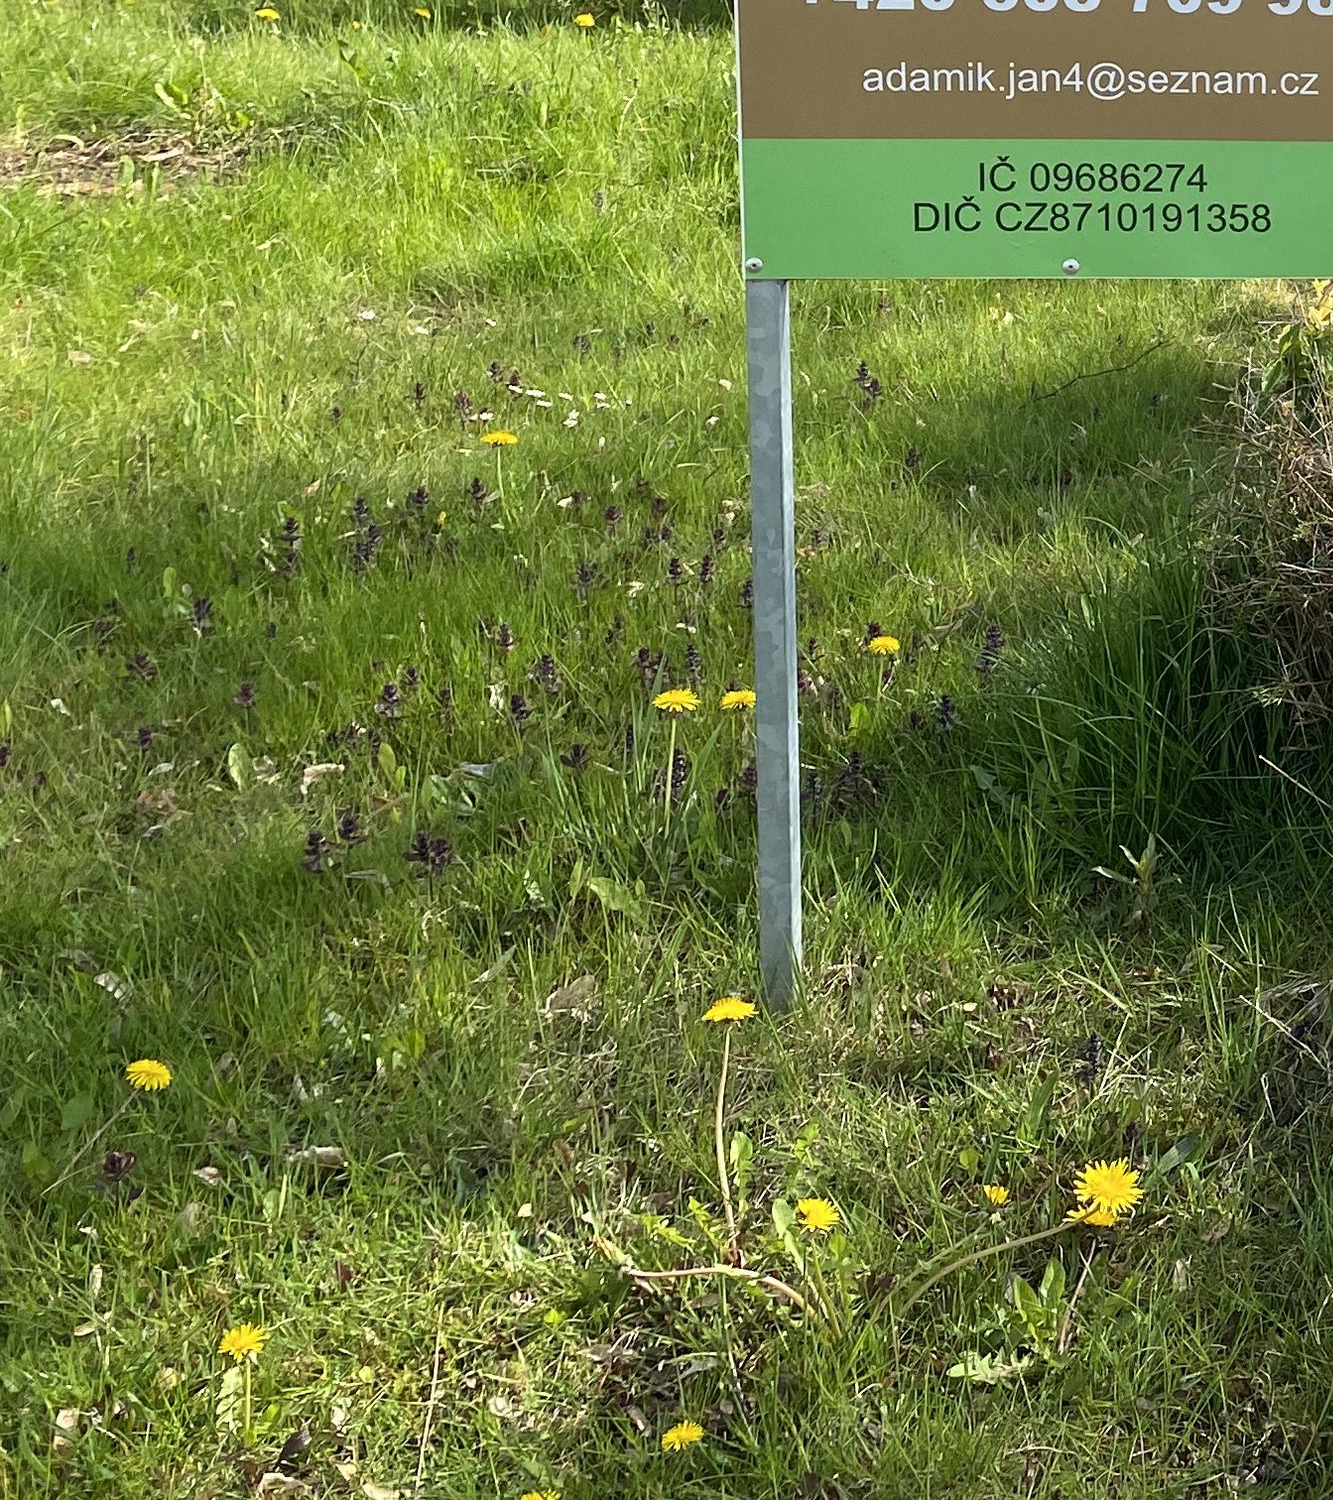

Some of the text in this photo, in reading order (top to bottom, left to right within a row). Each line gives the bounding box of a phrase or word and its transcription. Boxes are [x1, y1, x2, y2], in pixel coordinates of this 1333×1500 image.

[862, 61, 1320, 101] adamik.jan4@seznam.cz
[978, 155, 1208, 193] IČ 09686274
[913, 195, 1272, 233] DIČ CZ8710191358
